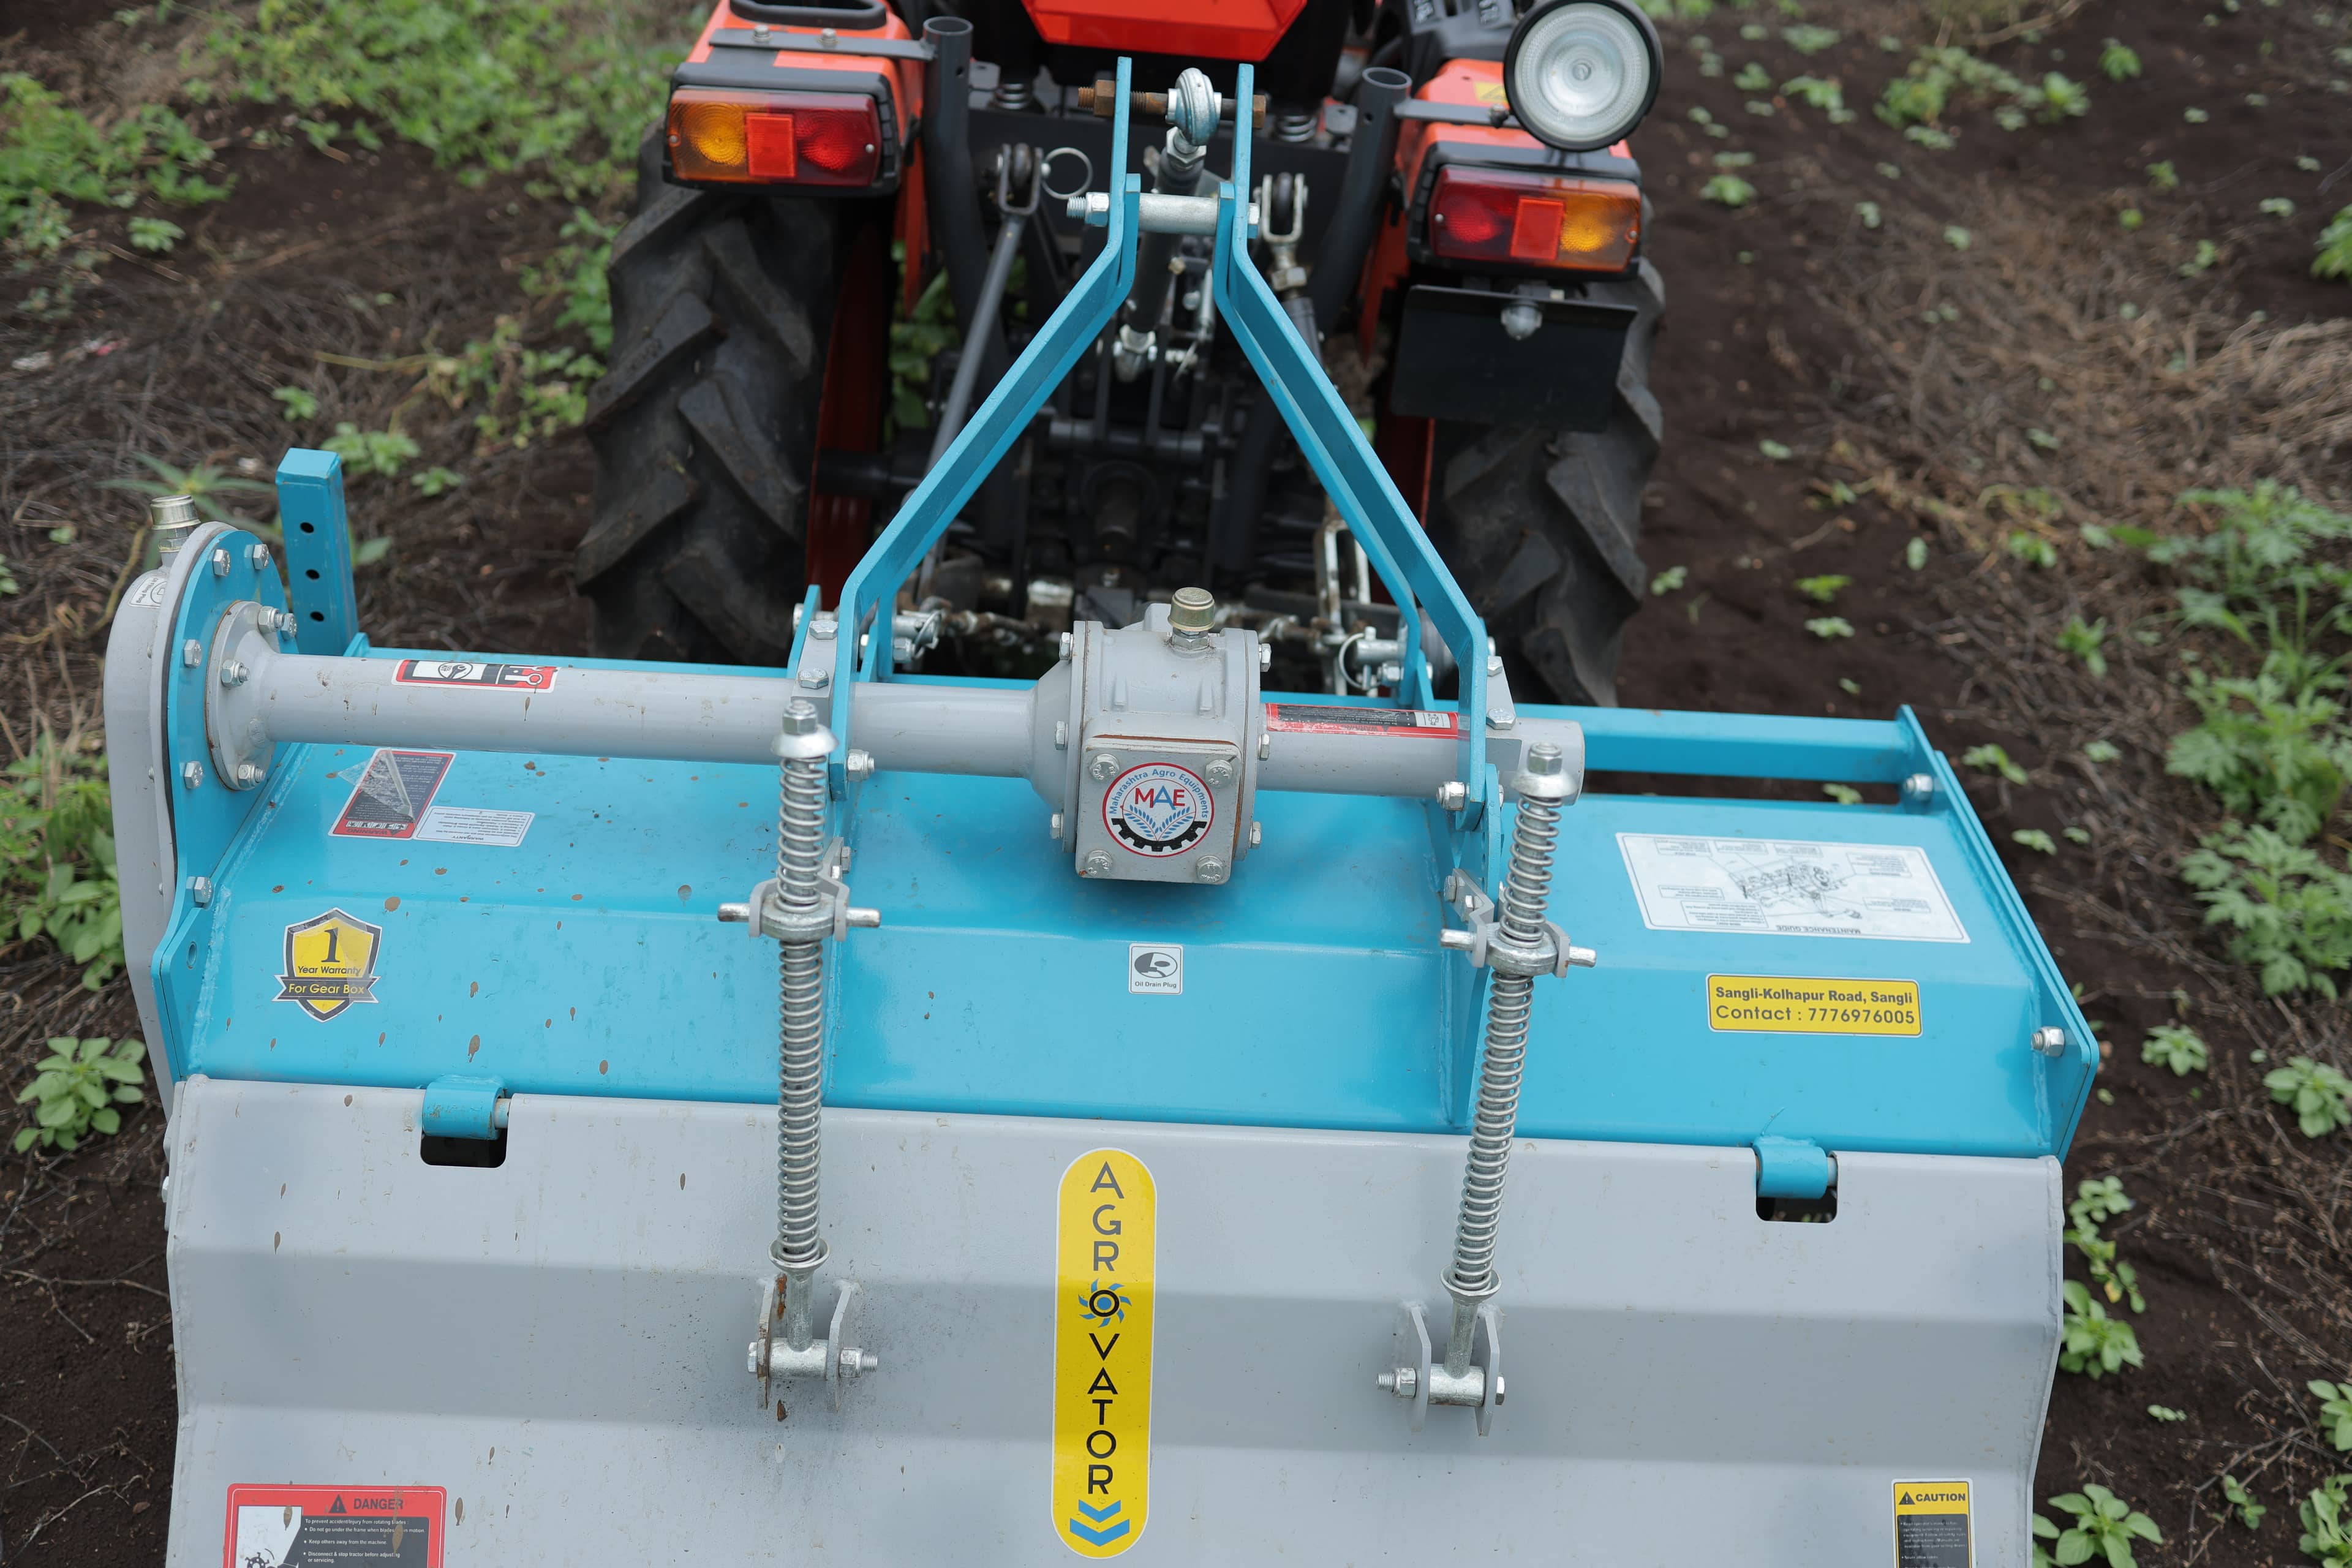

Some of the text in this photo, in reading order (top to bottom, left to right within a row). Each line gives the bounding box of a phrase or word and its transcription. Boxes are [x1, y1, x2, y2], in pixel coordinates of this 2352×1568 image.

[136, 594, 146, 603] Plug
[1109, 769, 1208, 818] Maharashtra Agro Equipments
[1135, 785, 1185, 810] MAE
[1803, 926, 1861, 935] MAINTENANCE
[321, 927, 340, 962] 1
[321, 966, 361, 976] Warranty
[288, 983, 364, 993] For Gear Box
[1716, 987, 1913, 1006] Sangli-Kolhapur Road, Sangli
[1716, 1005, 1791, 1020] Contact
[1808, 1008, 1915, 1024] 7776976005
[1086, 1161, 1125, 1494] AGROVATOR
[353, 1498, 403, 1509] DANGER
[1916, 1493, 1966, 1502] CAUTION
